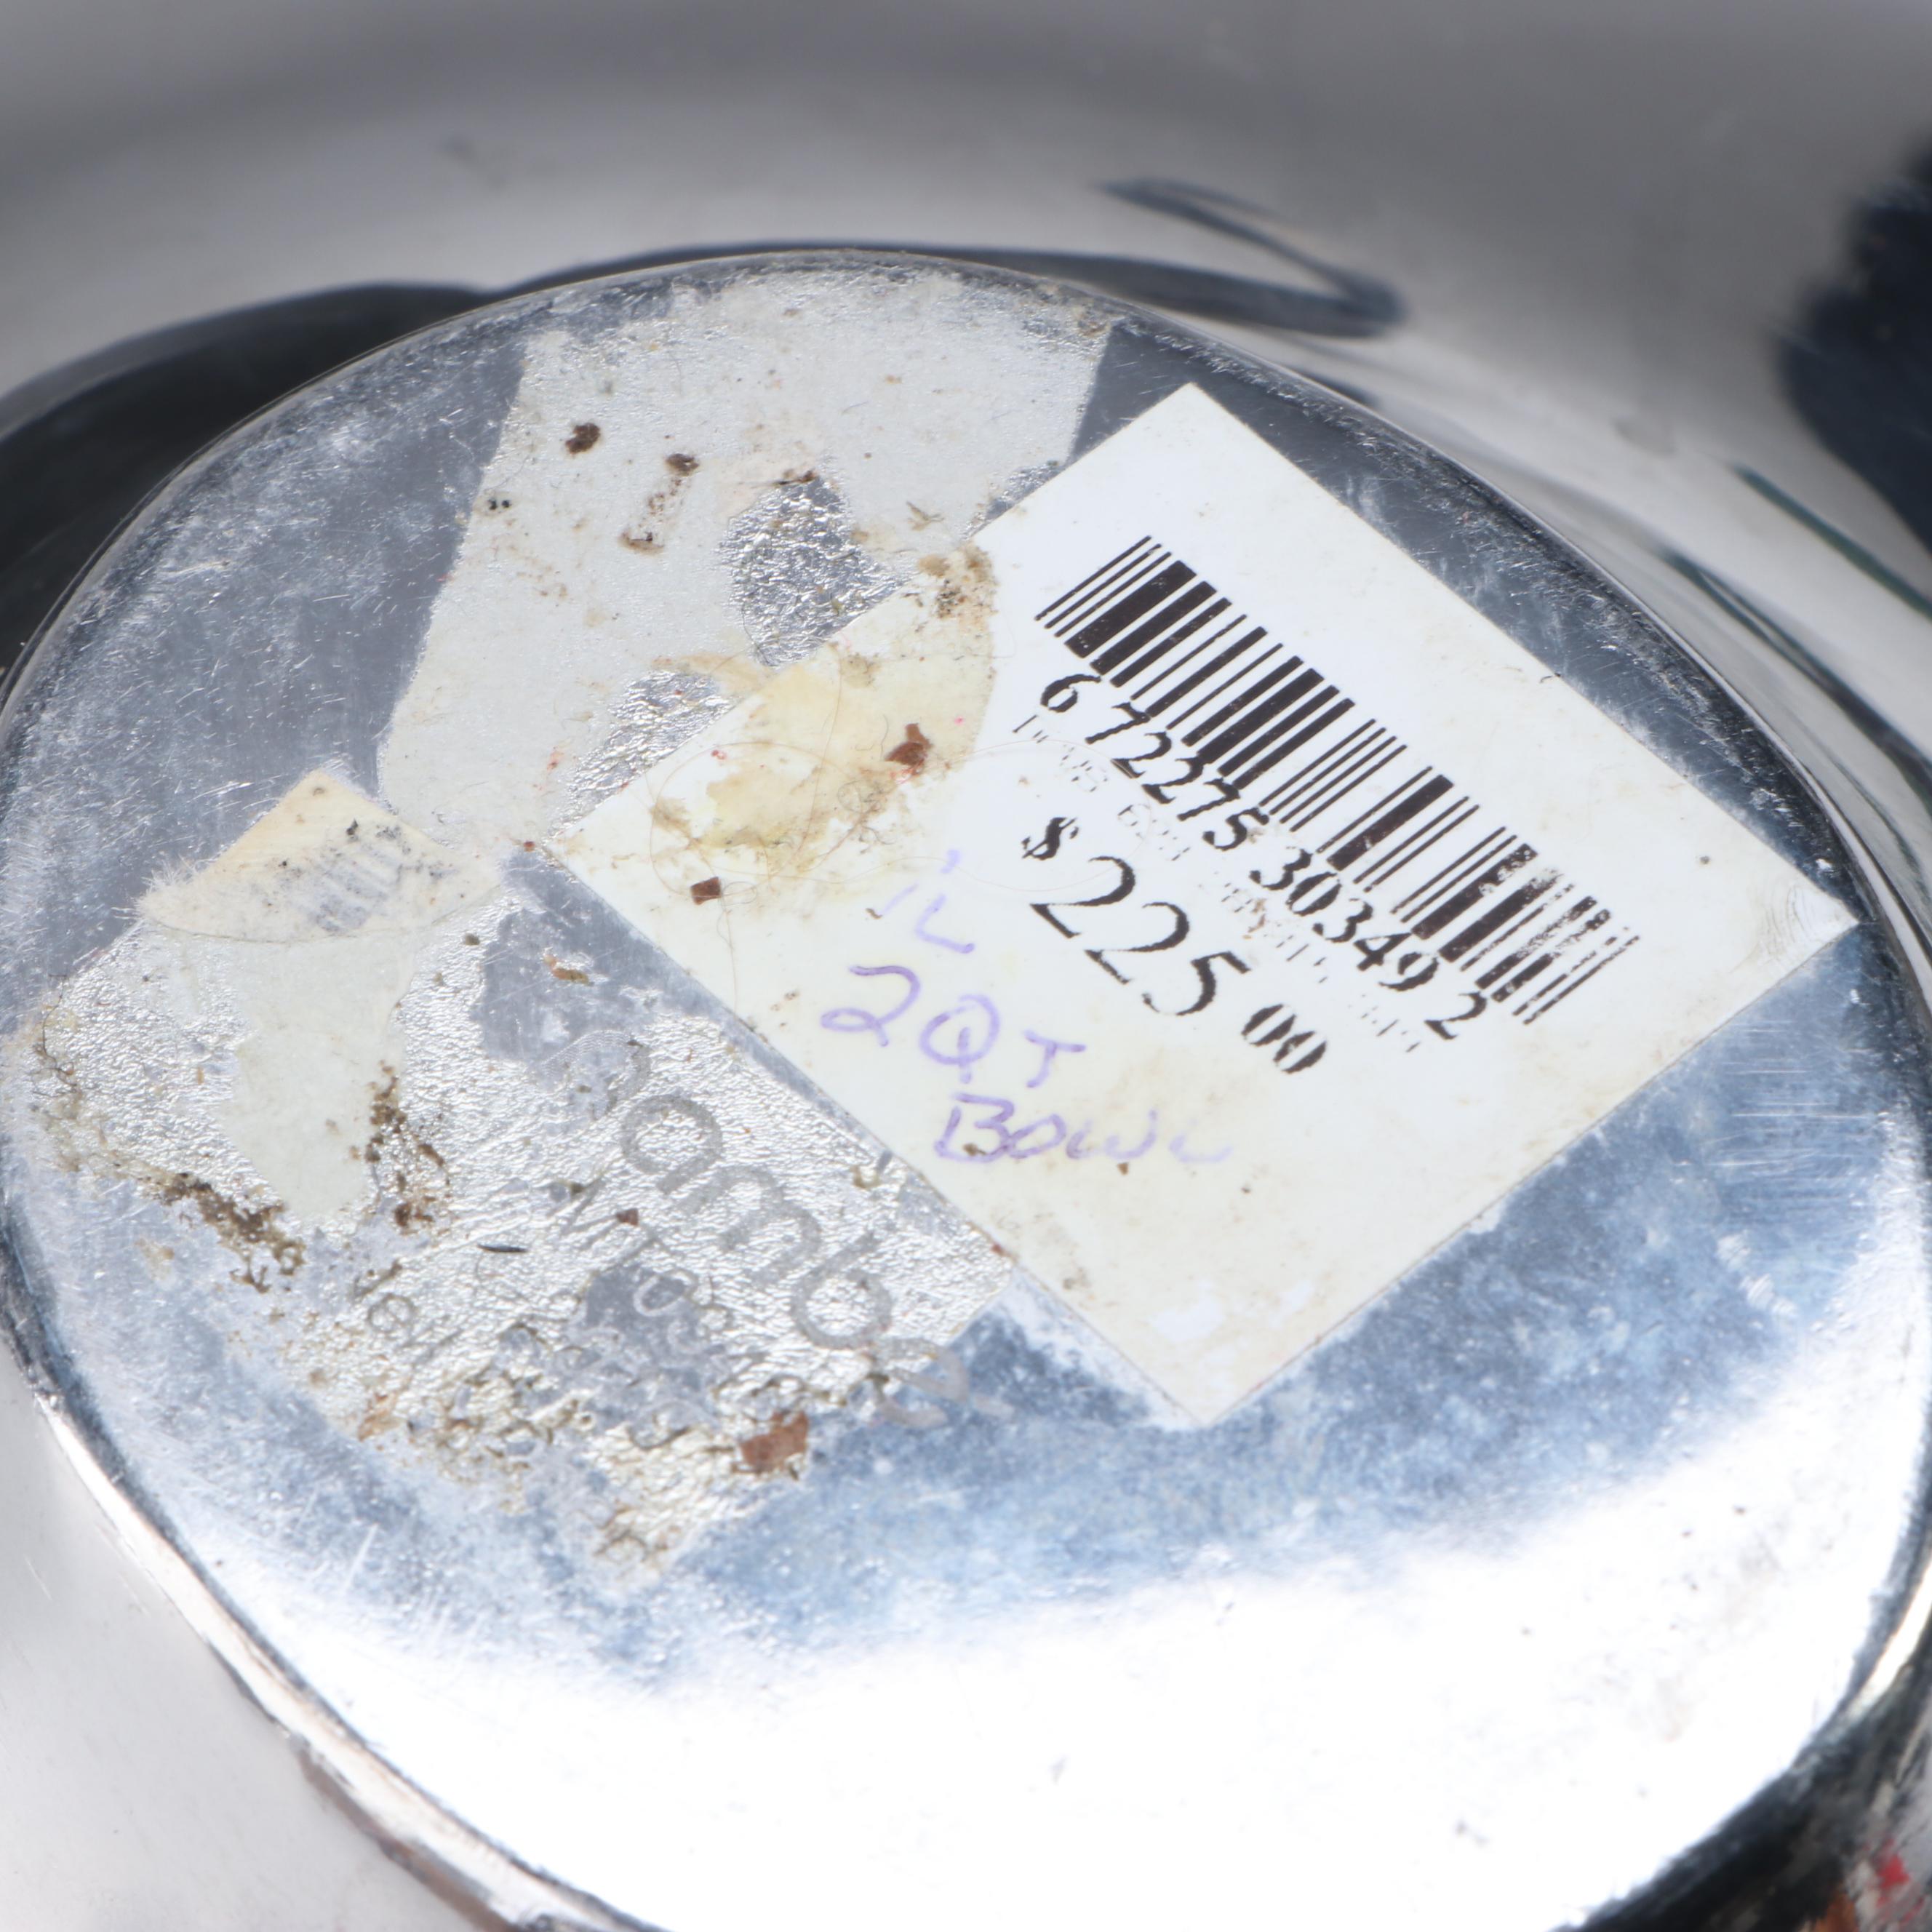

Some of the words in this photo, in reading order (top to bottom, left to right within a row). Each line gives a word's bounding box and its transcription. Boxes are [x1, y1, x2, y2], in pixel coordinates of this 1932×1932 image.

[1040, 673, 1102, 714] 6
[1085, 701, 1270, 852] 72275
[1250, 846, 1441, 992] 30349
[1424, 991, 1488, 1041] 2
